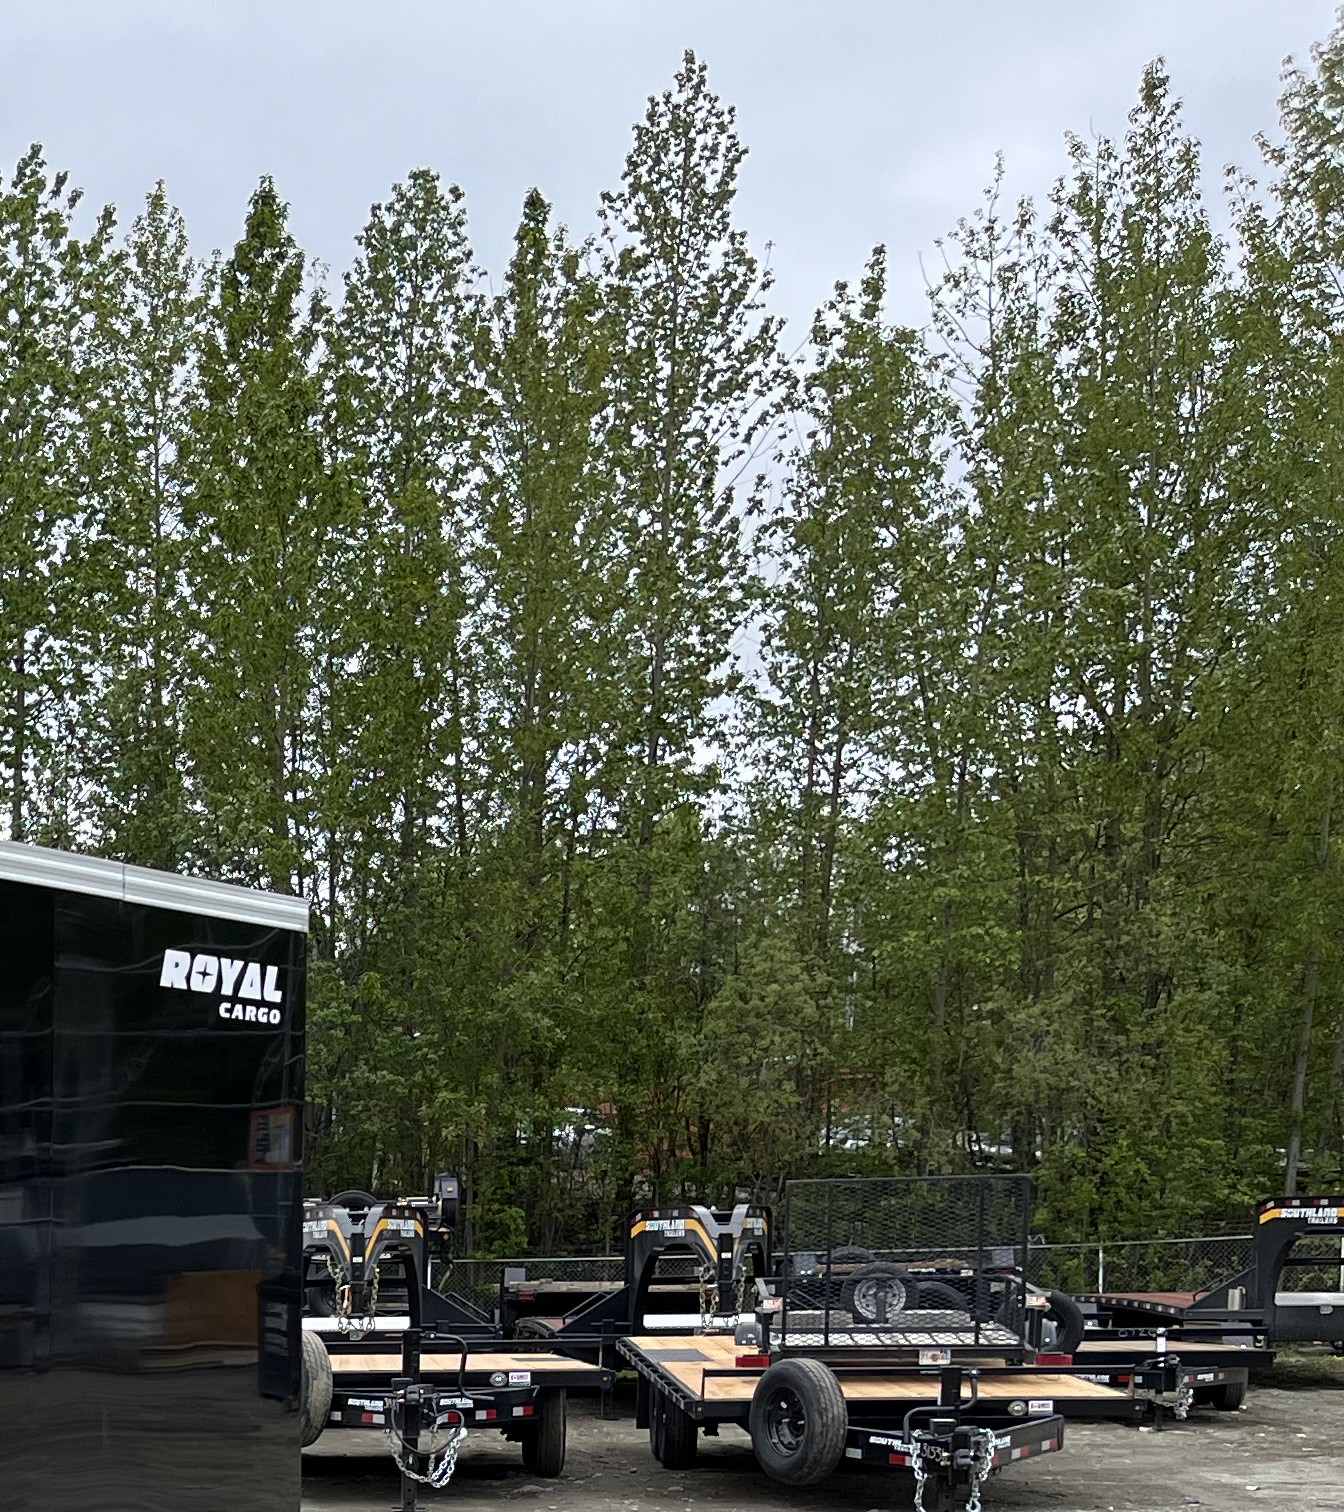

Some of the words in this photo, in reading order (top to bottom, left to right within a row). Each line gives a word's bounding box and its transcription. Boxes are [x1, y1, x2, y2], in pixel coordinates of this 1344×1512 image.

[159, 948, 283, 1003] ROYAL
[218, 1002, 281, 1024] CARGO
[1280, 1207, 1338, 1218] SOUTHLAND
